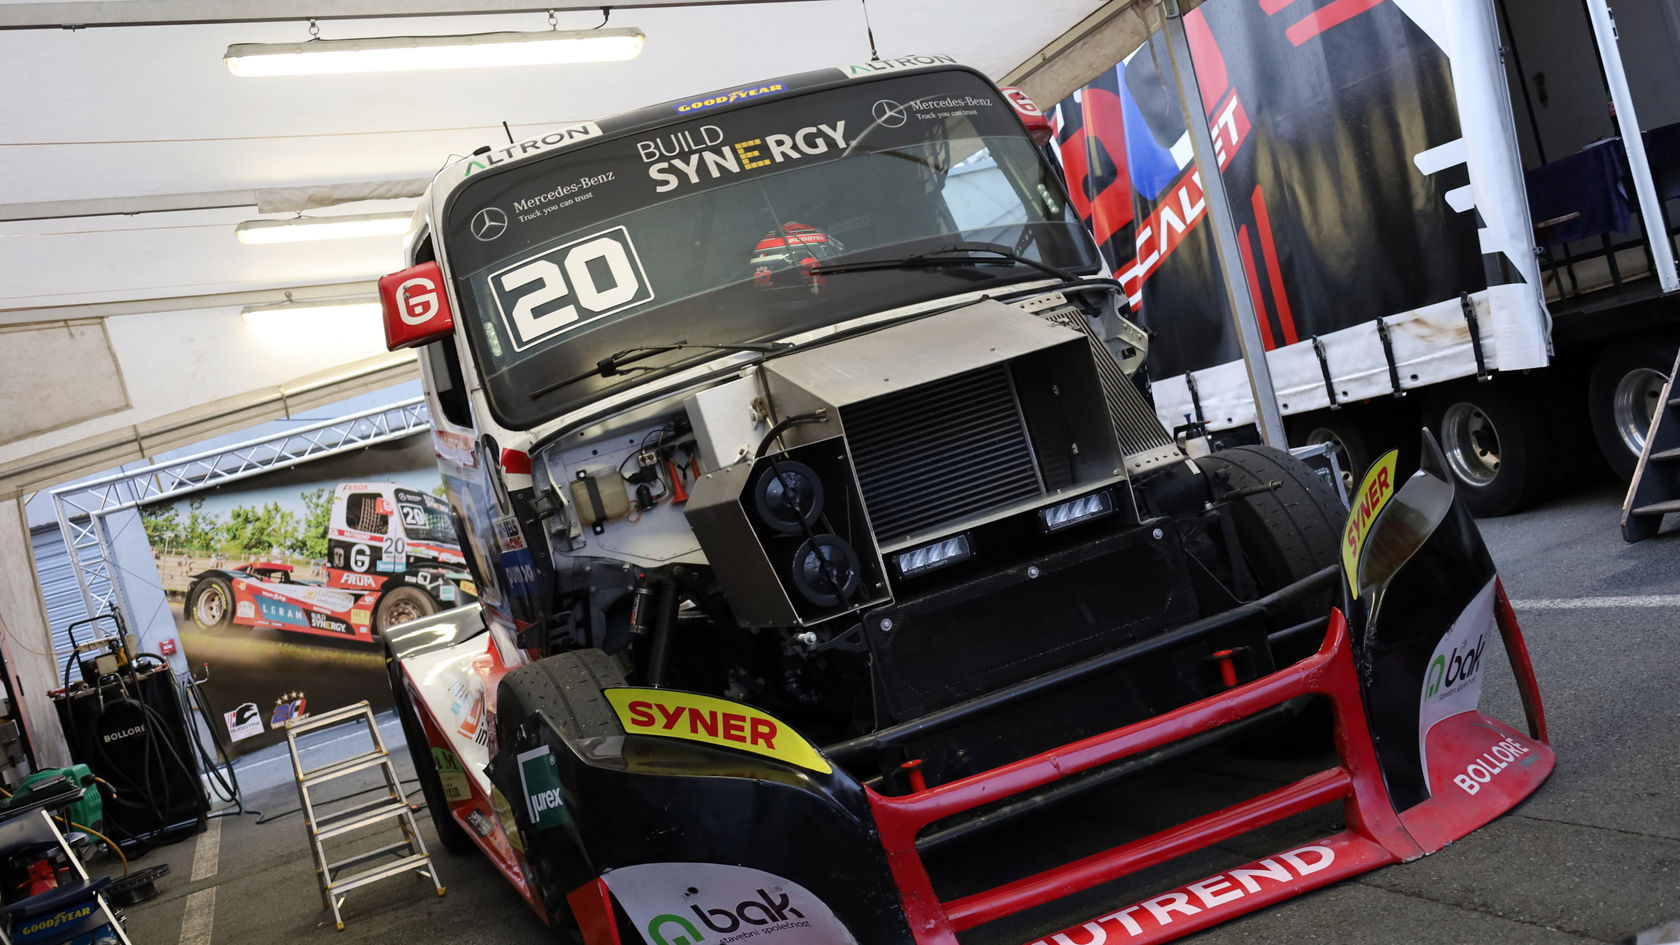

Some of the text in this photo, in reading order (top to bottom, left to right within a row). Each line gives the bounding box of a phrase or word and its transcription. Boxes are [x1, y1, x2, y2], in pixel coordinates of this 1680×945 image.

[850, 54, 956, 75] ALTRON
[678, 83, 783, 112] GOODYEAR
[911, 96, 993, 111] Mercedes-Benz
[916, 112, 936, 120] Truck
[464, 125, 590, 177] ALTRON
[636, 125, 724, 163] BUILD
[648, 120, 847, 193] SYNERGY
[513, 171, 616, 214] Mercedes-Benz
[518, 192, 593, 223] Truck you can trust
[500, 237, 640, 343] 20
[403, 506, 424, 525] 20
[1347, 466, 1390, 558] SYNER
[384, 537, 405, 555] 20
[628, 700, 778, 750] SYNER
[531, 787, 564, 823] jurex
[22, 907, 91, 935] GOODYEAR
[690, 888, 806, 934] bak
[762, 919, 812, 936] společnost
